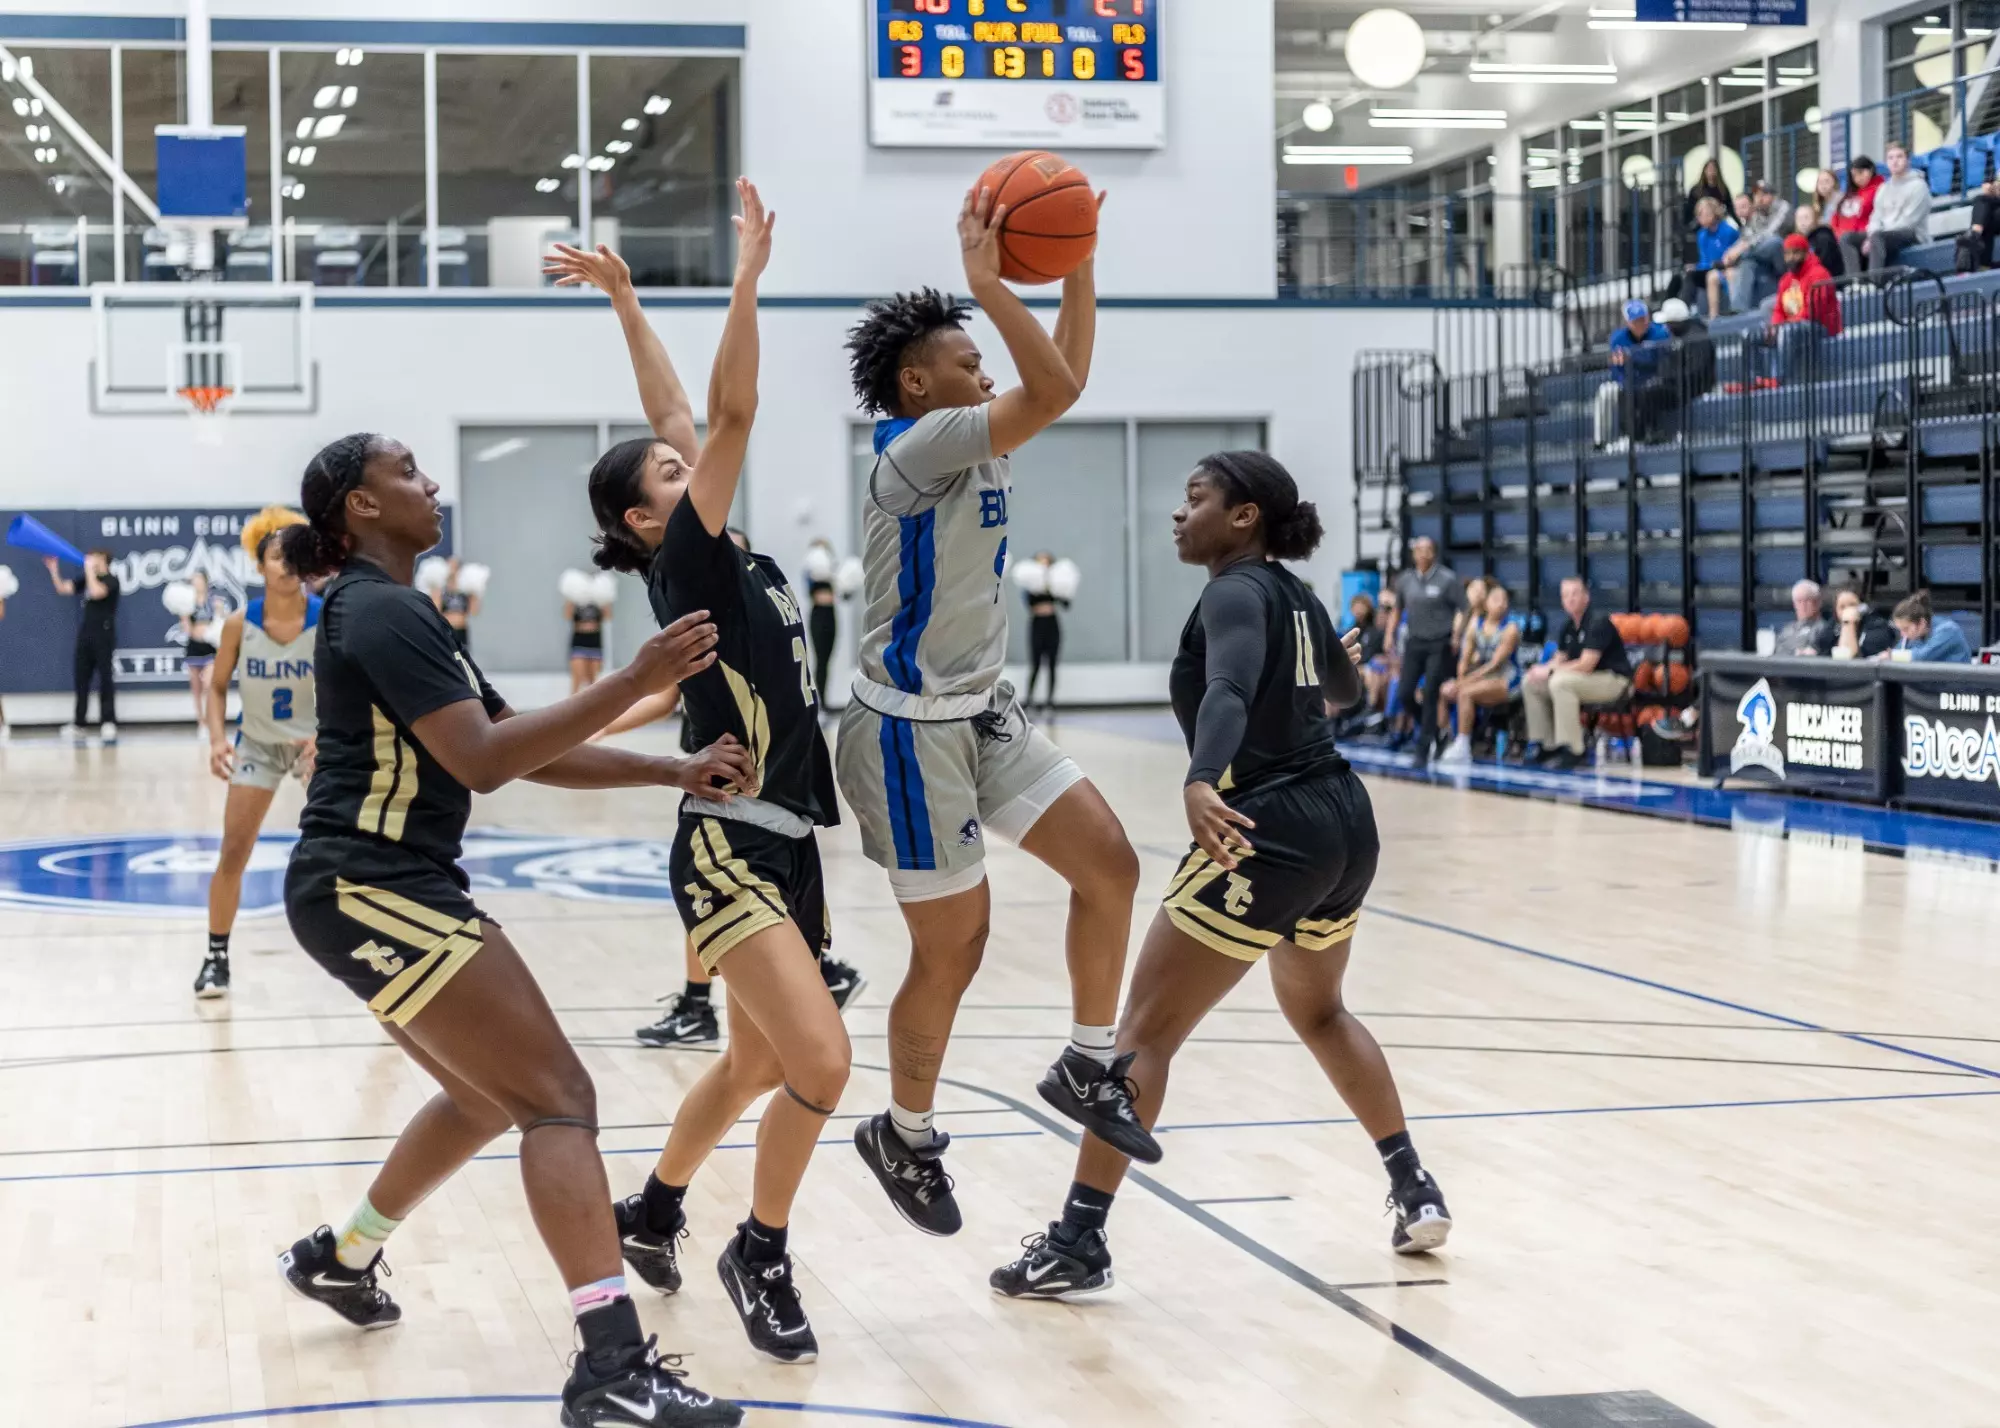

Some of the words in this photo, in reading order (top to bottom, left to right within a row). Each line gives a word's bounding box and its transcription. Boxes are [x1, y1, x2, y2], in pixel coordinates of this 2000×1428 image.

[901, 45, 922, 77] 3
[941, 45, 965, 78] 0
[993, 46, 1026, 79] 13
[1042, 48, 1054, 77] 1
[1072, 47, 1096, 79] 0
[979, 487, 1012, 529] BL
[101, 516, 180, 537] BLINN
[193, 514, 249, 536] COL
[1293, 610, 1320, 687] 11
[271, 687, 294, 721] 2
[1939, 692, 1980, 711] BLINN
[1786, 701, 1863, 743] BUCCANEER
[1787, 737, 1832, 768] BACKER
[1832, 742, 1863, 771] CLUB
[683, 881, 714, 919] TC
[1224, 871, 1254, 917] TC
[350, 938, 405, 977] TC
